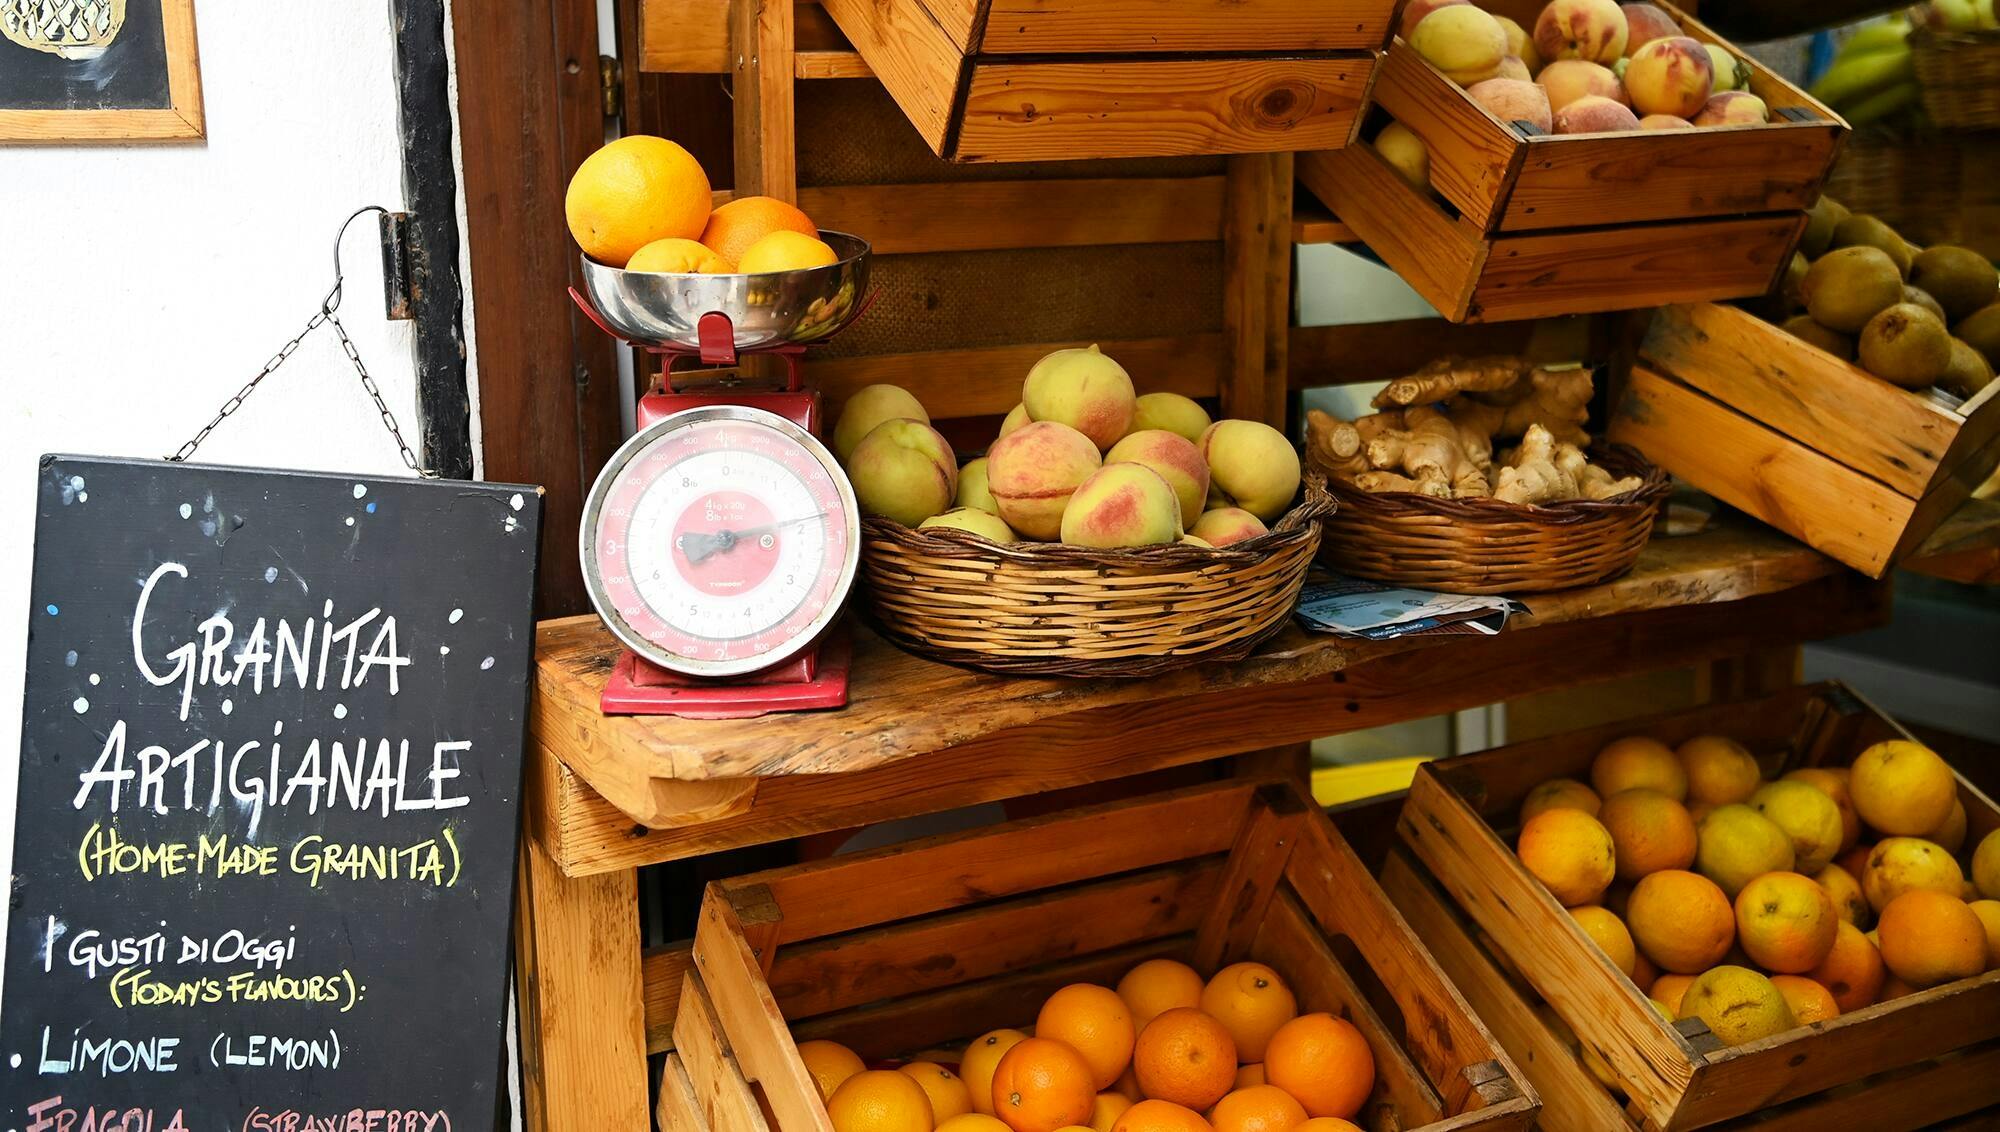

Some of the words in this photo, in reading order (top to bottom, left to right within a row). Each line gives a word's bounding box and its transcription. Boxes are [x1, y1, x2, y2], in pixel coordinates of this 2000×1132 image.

[784, 448, 801, 458] 400
[721, 465, 731, 477] 0
[809, 471, 826, 481] 600
[797, 524, 806, 536] 2
[605, 539, 618, 556] 3
[652, 569, 661, 581] 6
[785, 574, 795, 586] 3
[624, 606, 641, 616] 600
[689, 604, 699, 617] 5
[743, 607, 752, 617] 4
[132, 562, 411, 721] GRANITA
[73, 720, 473, 840] ARTIGIANALE
[78, 823, 279, 882] (HOME-MADE
[290, 828, 462, 887] GRANITA)
[68, 920, 167, 979] GUSTI
[109, 968, 223, 1009] (TODAY'S
[38, 1026, 181, 1078] LIMONE
[210, 1028, 341, 1071] (LEMON)
